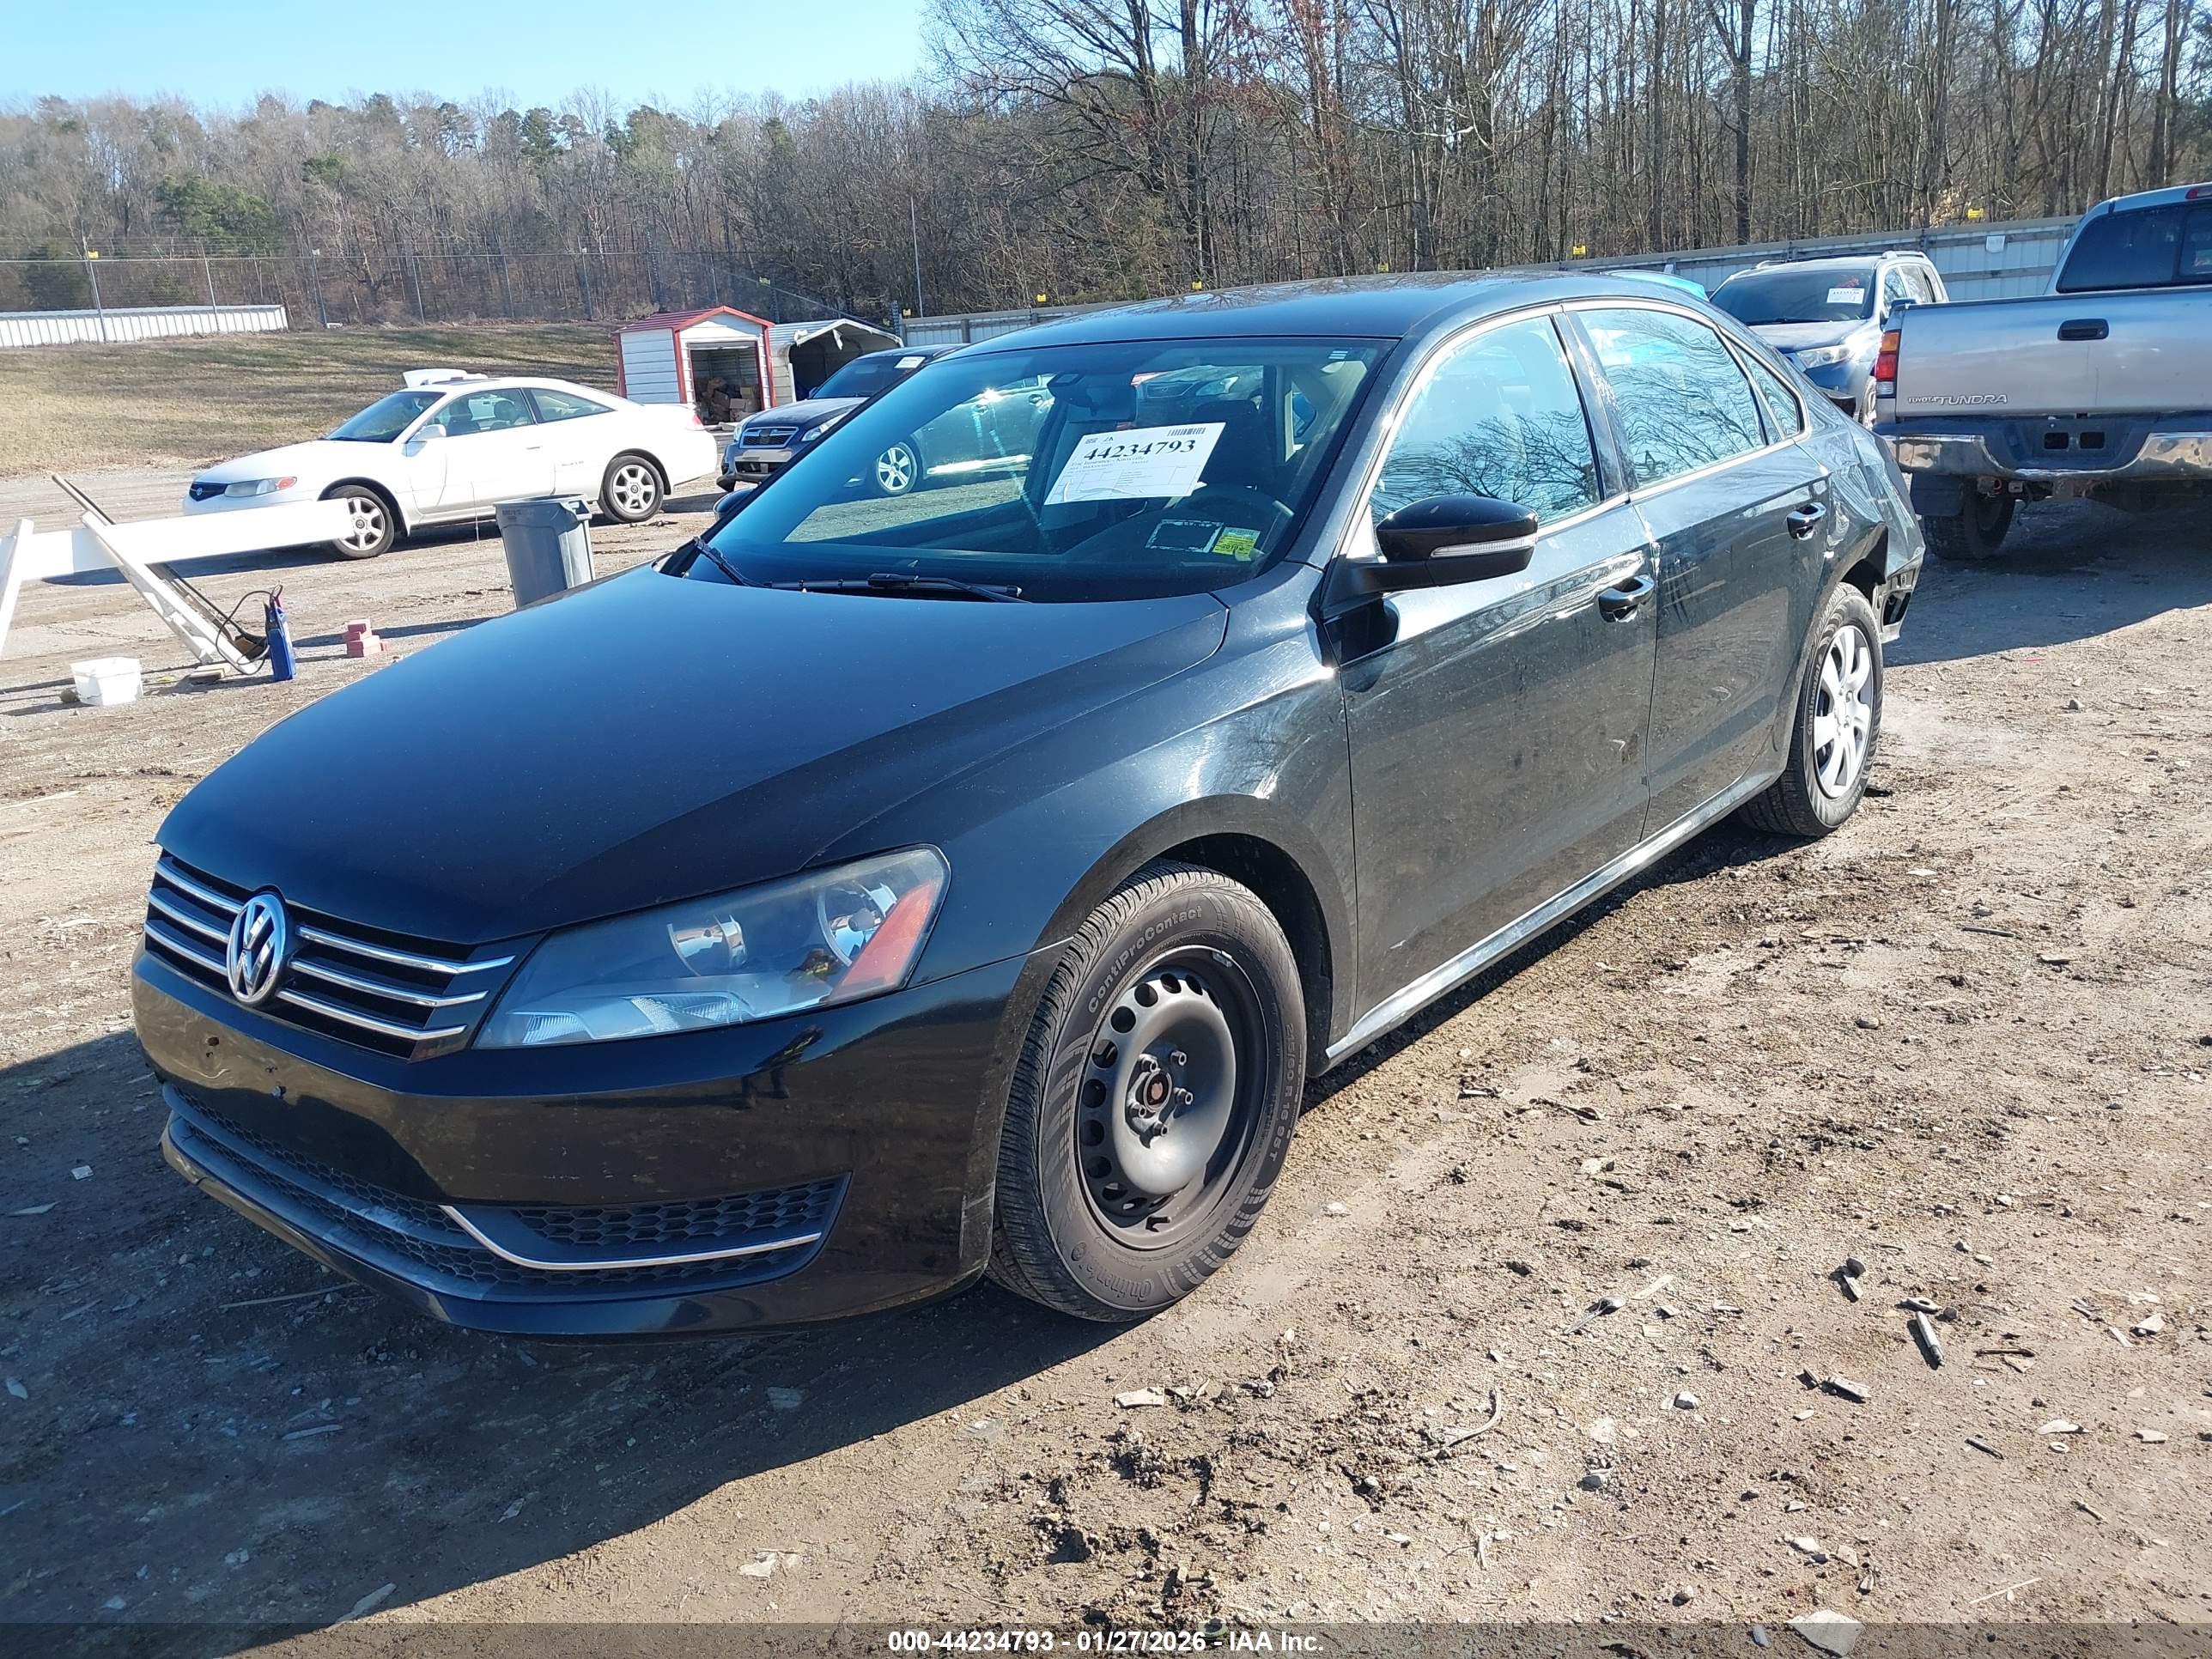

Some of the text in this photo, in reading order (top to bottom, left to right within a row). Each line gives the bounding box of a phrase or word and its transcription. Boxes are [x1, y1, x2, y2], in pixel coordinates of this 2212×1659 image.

[1936, 394, 2008, 406] TUNDRA
[1084, 439, 1196, 460] 44234793
[1088, 905, 1203, 1013] ContiProContact
